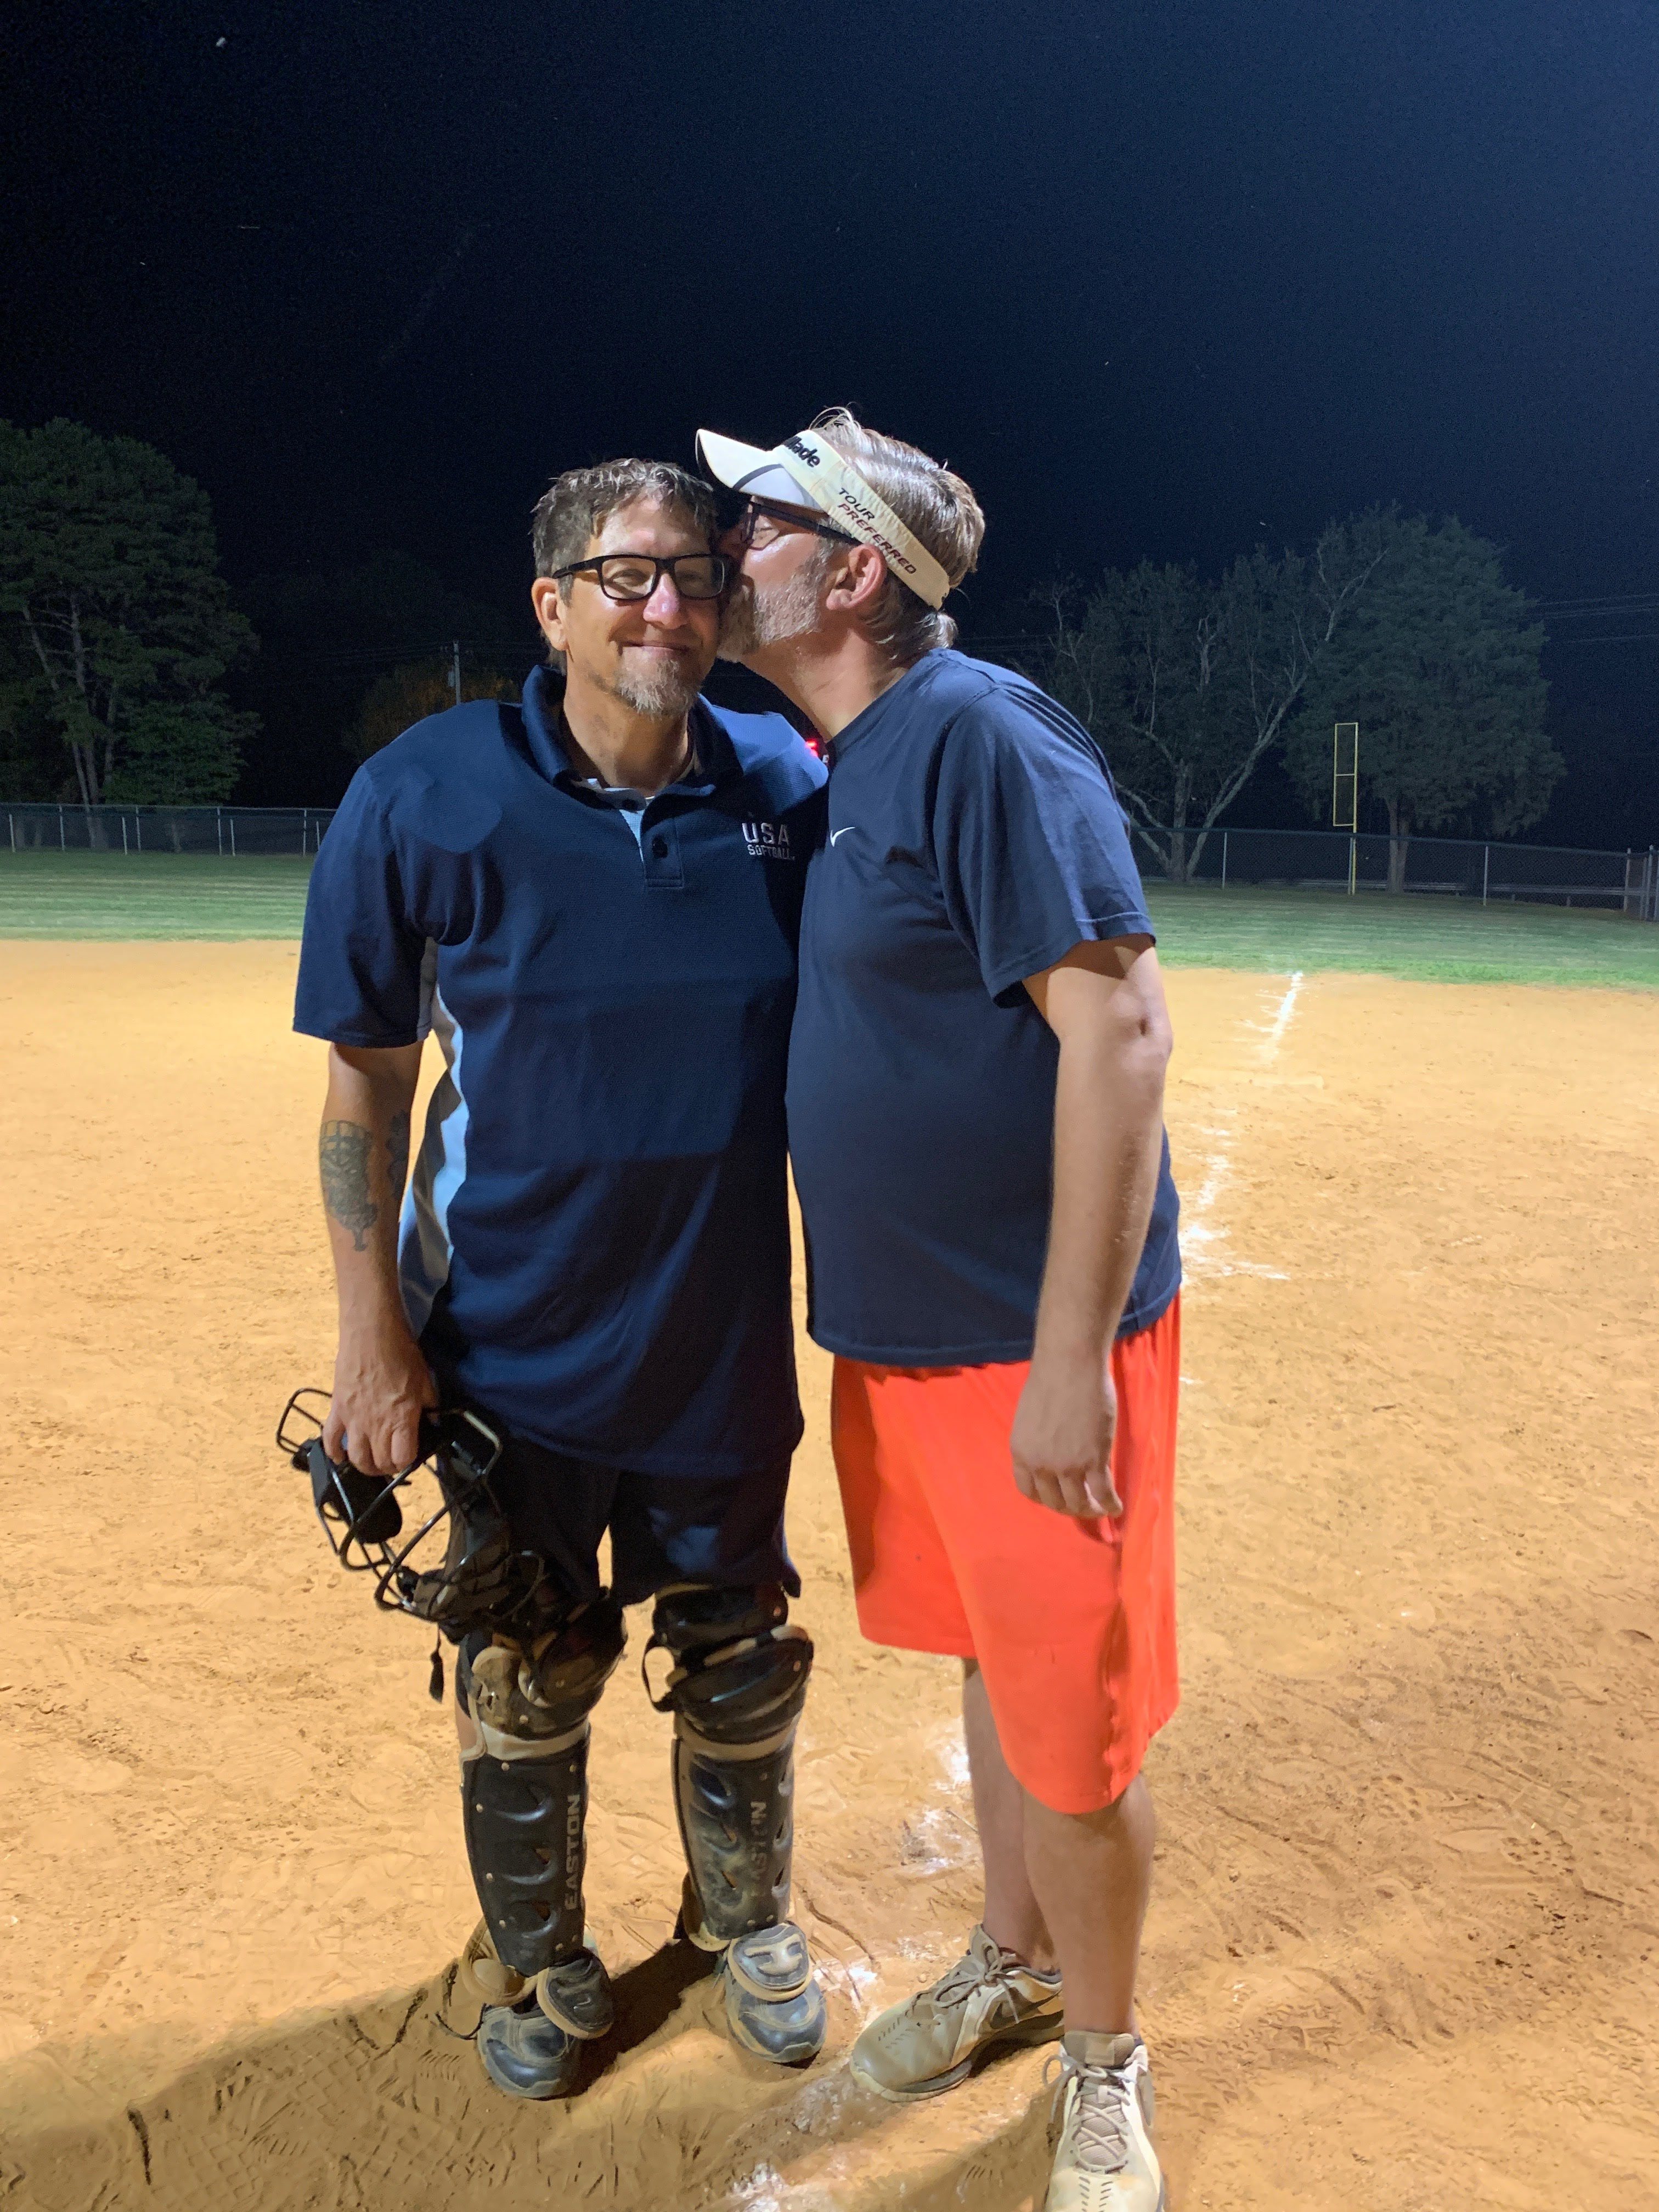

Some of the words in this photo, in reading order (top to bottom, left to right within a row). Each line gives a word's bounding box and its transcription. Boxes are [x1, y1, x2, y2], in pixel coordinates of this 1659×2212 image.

[839, 488, 875, 521] TOUR
[837, 503, 917, 574] PREFERRED
[742, 822, 789, 847] USA
[565, 1794, 580, 1910] EASTON
